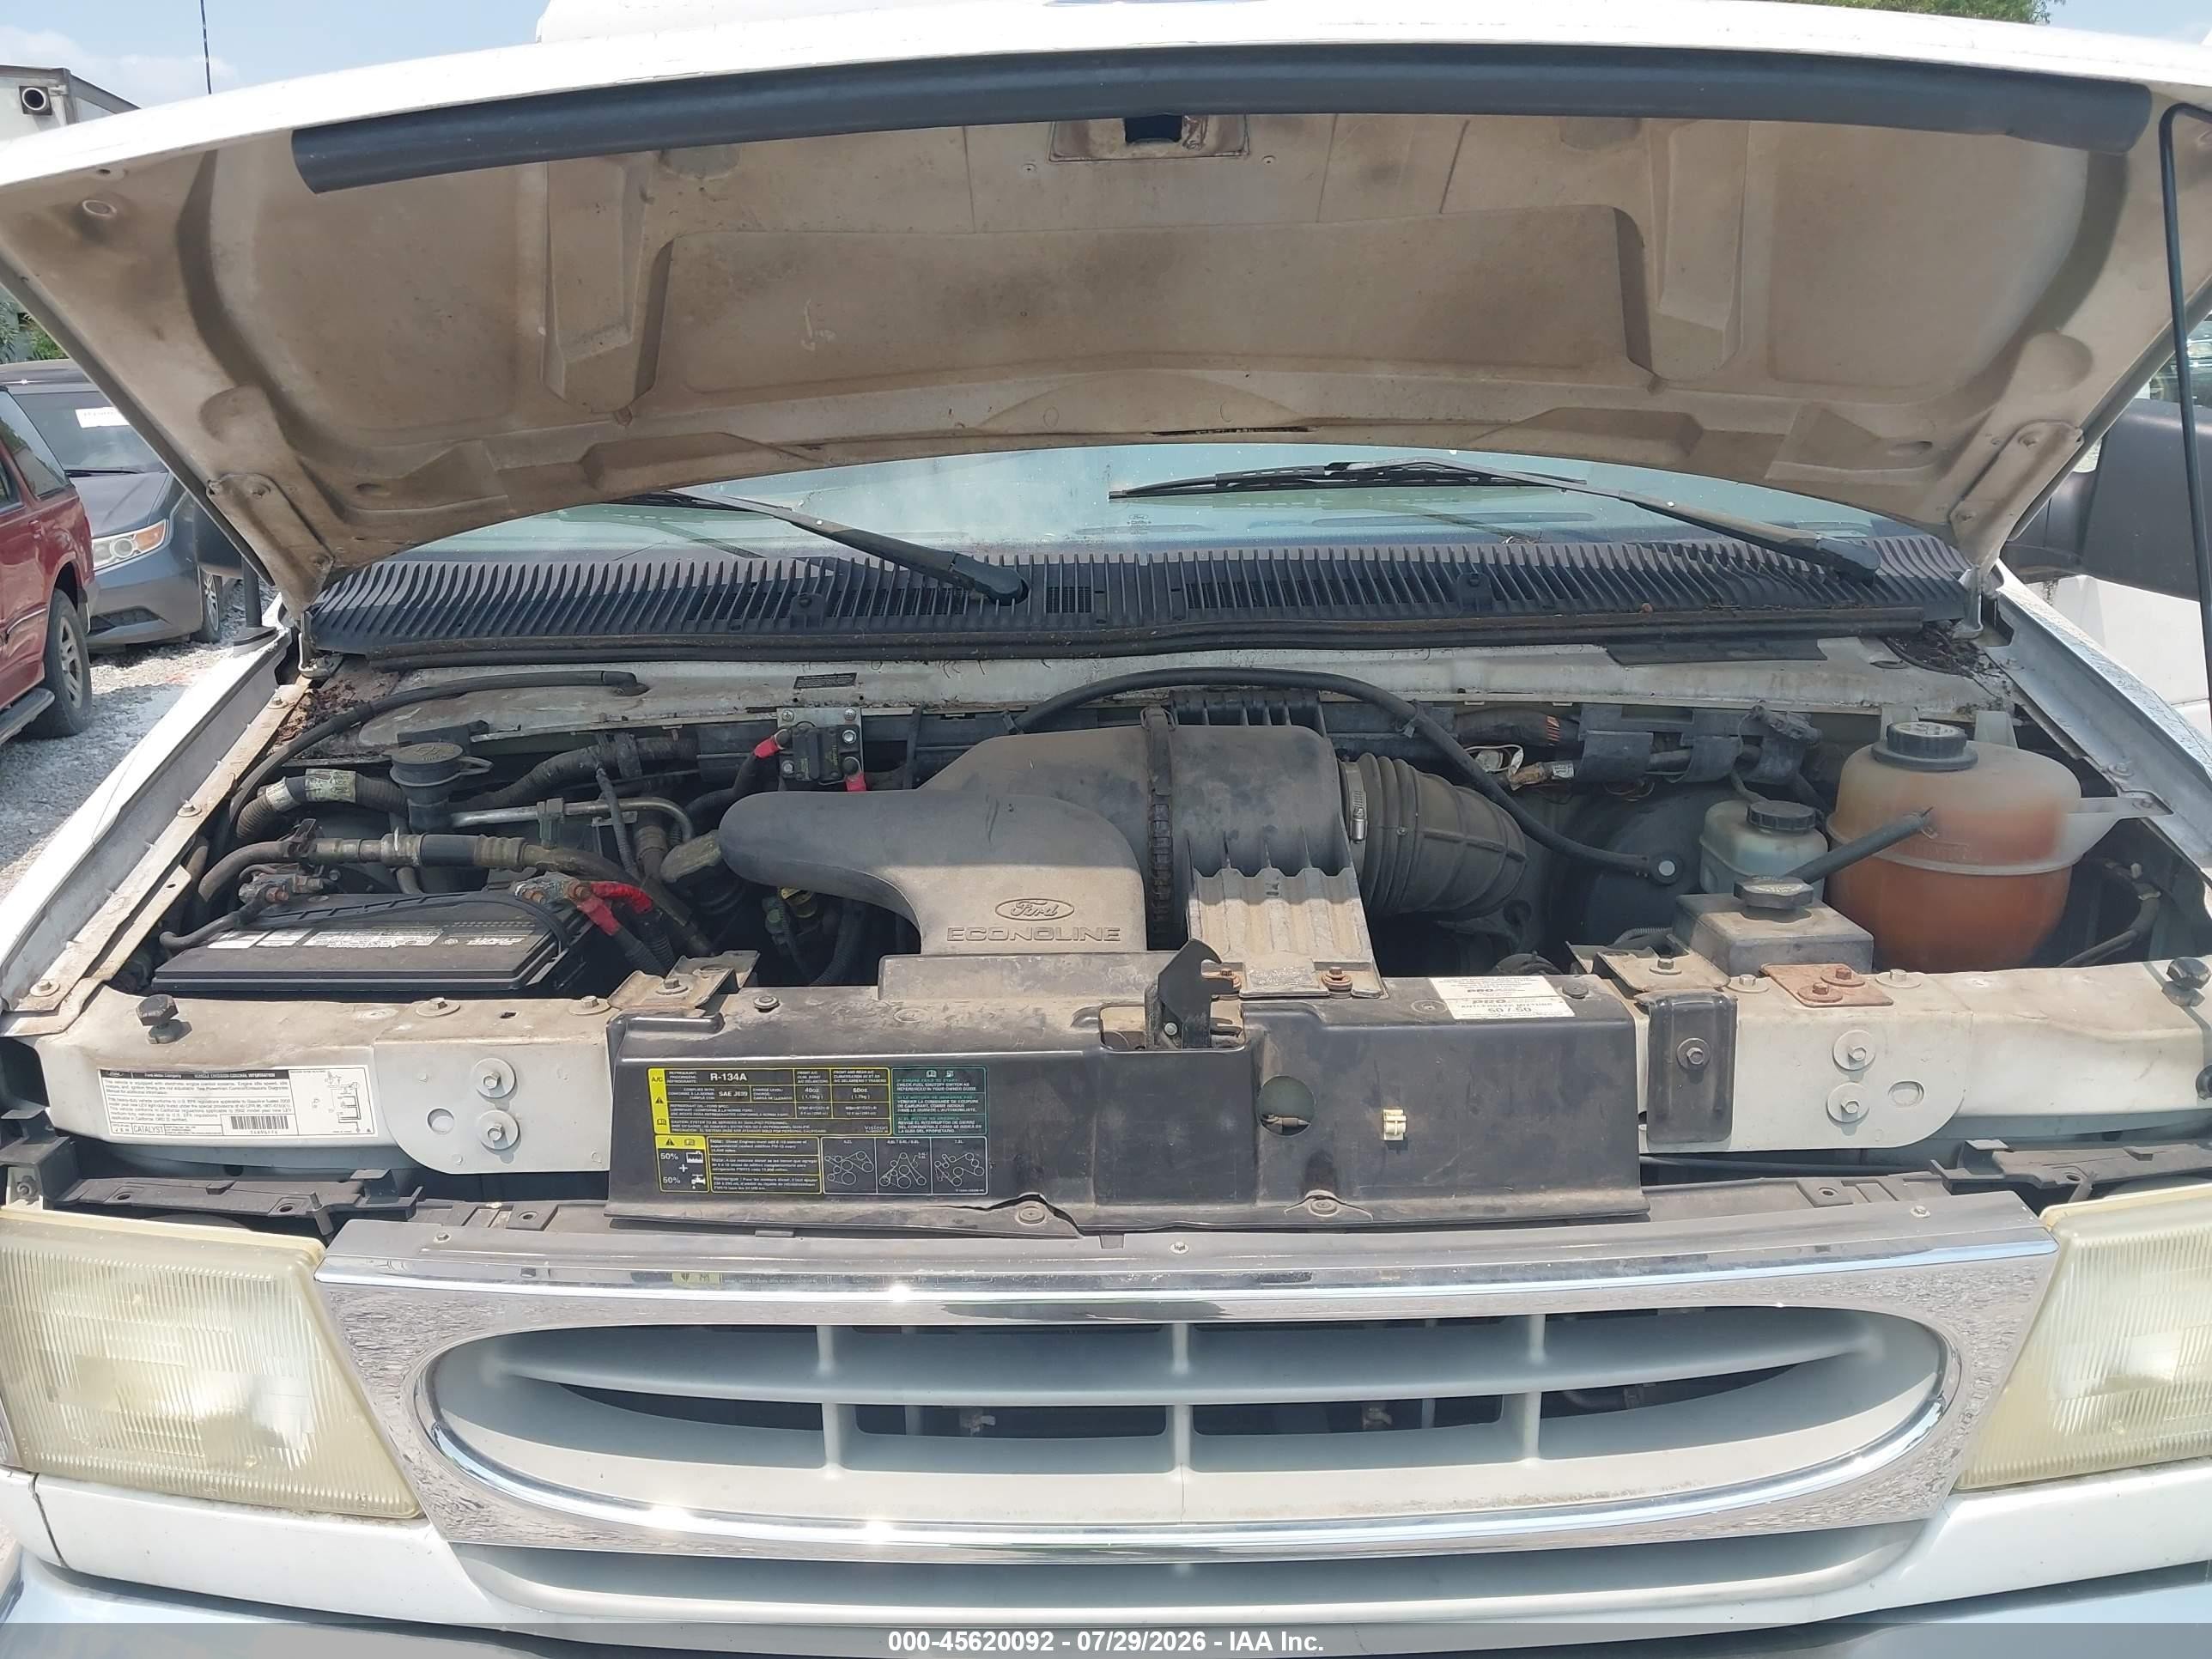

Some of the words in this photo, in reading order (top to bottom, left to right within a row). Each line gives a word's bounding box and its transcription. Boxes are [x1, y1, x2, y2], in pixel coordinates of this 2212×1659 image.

[1011, 900, 1058, 917] Ford
[947, 927, 1120, 941] ECONOLINE
[133, 1125, 164, 1133] CATALYST
